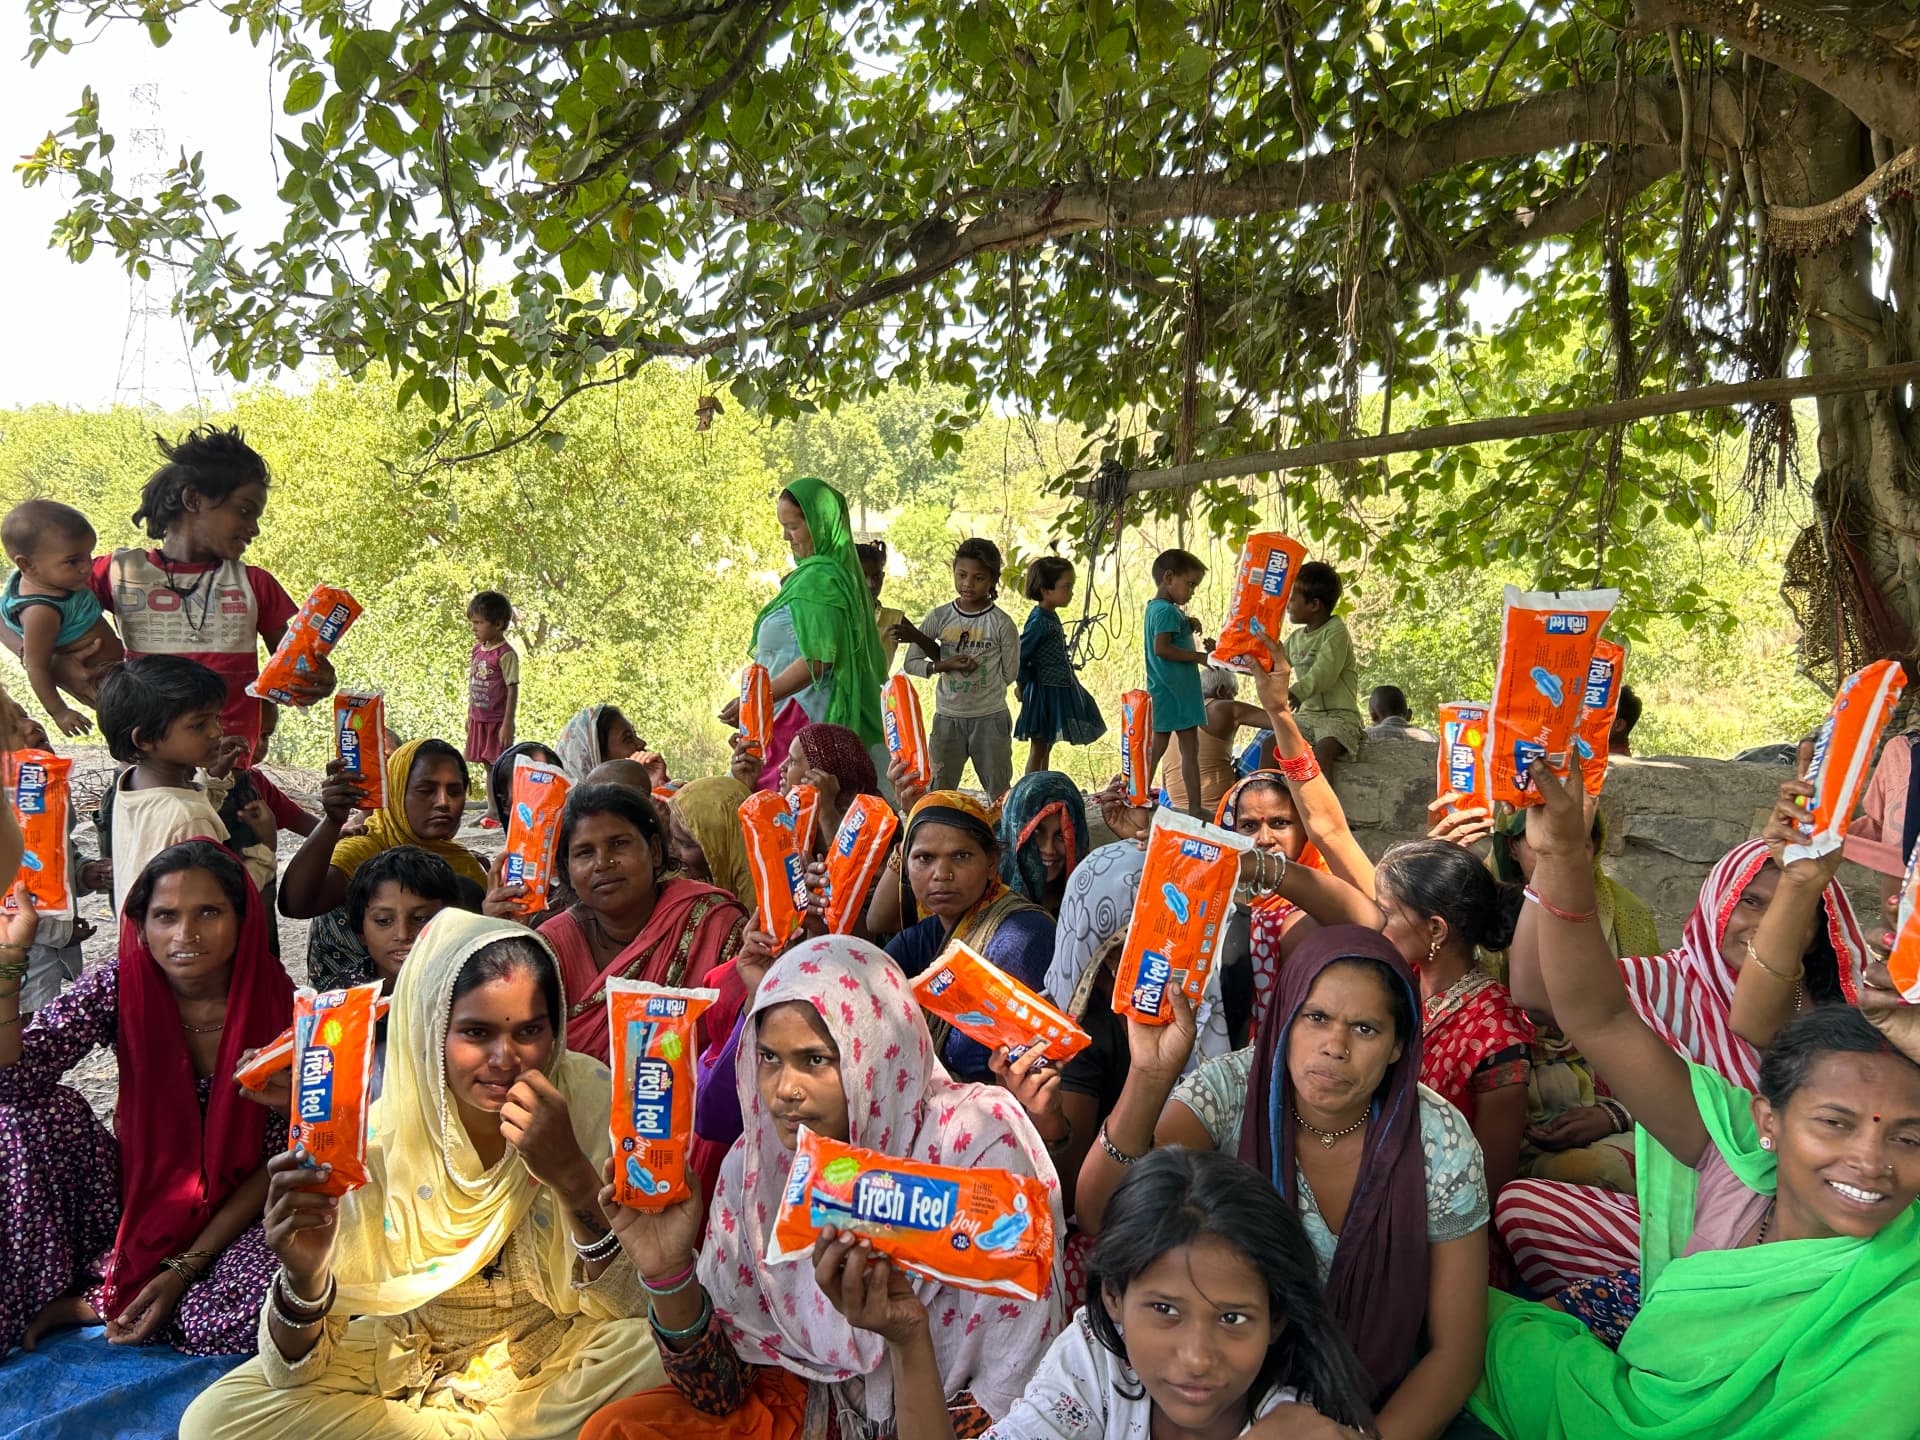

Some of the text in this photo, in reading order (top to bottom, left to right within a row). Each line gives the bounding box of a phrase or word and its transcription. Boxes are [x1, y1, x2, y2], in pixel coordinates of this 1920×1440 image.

[1263, 551, 1287, 593] Fresh Feel
[319, 604, 350, 641] Fresh Feel
[1549, 615, 1567, 631] Feel
[1567, 616, 1588, 633] Fresh
[1588, 660, 1611, 684] Fresh
[1584, 685, 1605, 705] Feel
[341, 730, 356, 751] Fresh
[20, 765, 43, 790] Fresh
[1452, 746, 1472, 790] Fresh Feel
[19, 791, 41, 811] Feel
[1184, 840, 1200, 856] Feel
[1199, 843, 1220, 861] Fresh
[509, 856, 524, 875] Feel
[789, 856, 804, 881] Feel
[1143, 955, 1169, 982] Feel
[649, 999, 665, 1013] Feel
[665, 1000, 686, 1014] Fresh
[1135, 983, 1162, 1013] Fresh
[303, 1050, 329, 1085] Fresh
[638, 1062, 667, 1100] Fresh
[301, 1088, 326, 1118] Feel
[636, 1106, 665, 1134] Feel
[634, 1135, 652, 1160] Joy
[857, 1176, 981, 1237] Fresh Feel Joy
